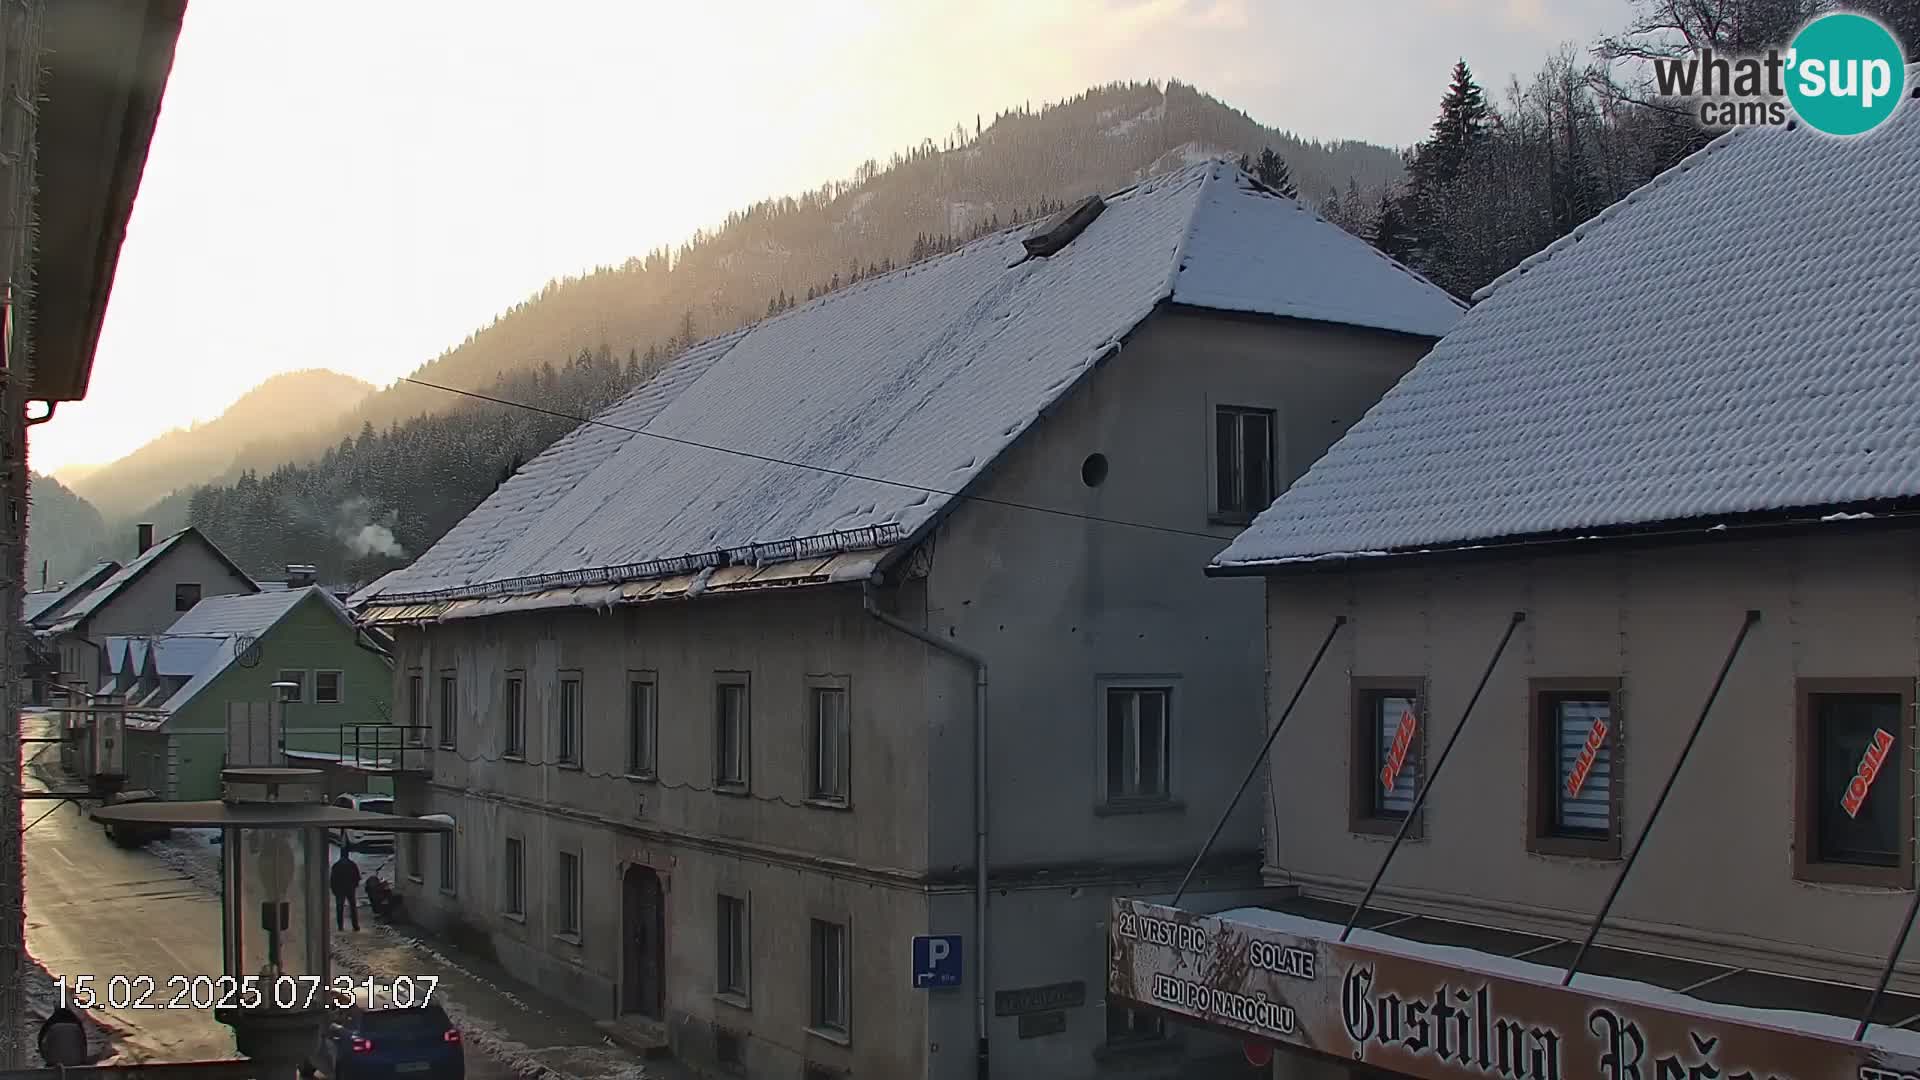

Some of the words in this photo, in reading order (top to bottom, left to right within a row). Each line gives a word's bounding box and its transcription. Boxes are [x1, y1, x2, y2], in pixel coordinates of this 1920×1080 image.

[1380, 711, 1415, 793] PIZZE
[1565, 718, 1607, 799] MALICE
[1841, 727, 1896, 818] KOSILA
[929, 939, 950, 969] P
[1119, 912, 1137, 937] 21
[1140, 916, 1176, 946] VRST
[1179, 925, 1206, 951] PIC
[1249, 941, 1315, 978] SOLATE
[1153, 974, 1184, 1004] JEDI
[1186, 981, 1211, 1010] PO
[1211, 988, 1295, 1033] NAROČILU
[1343, 961, 1561, 1080] Gostilna
